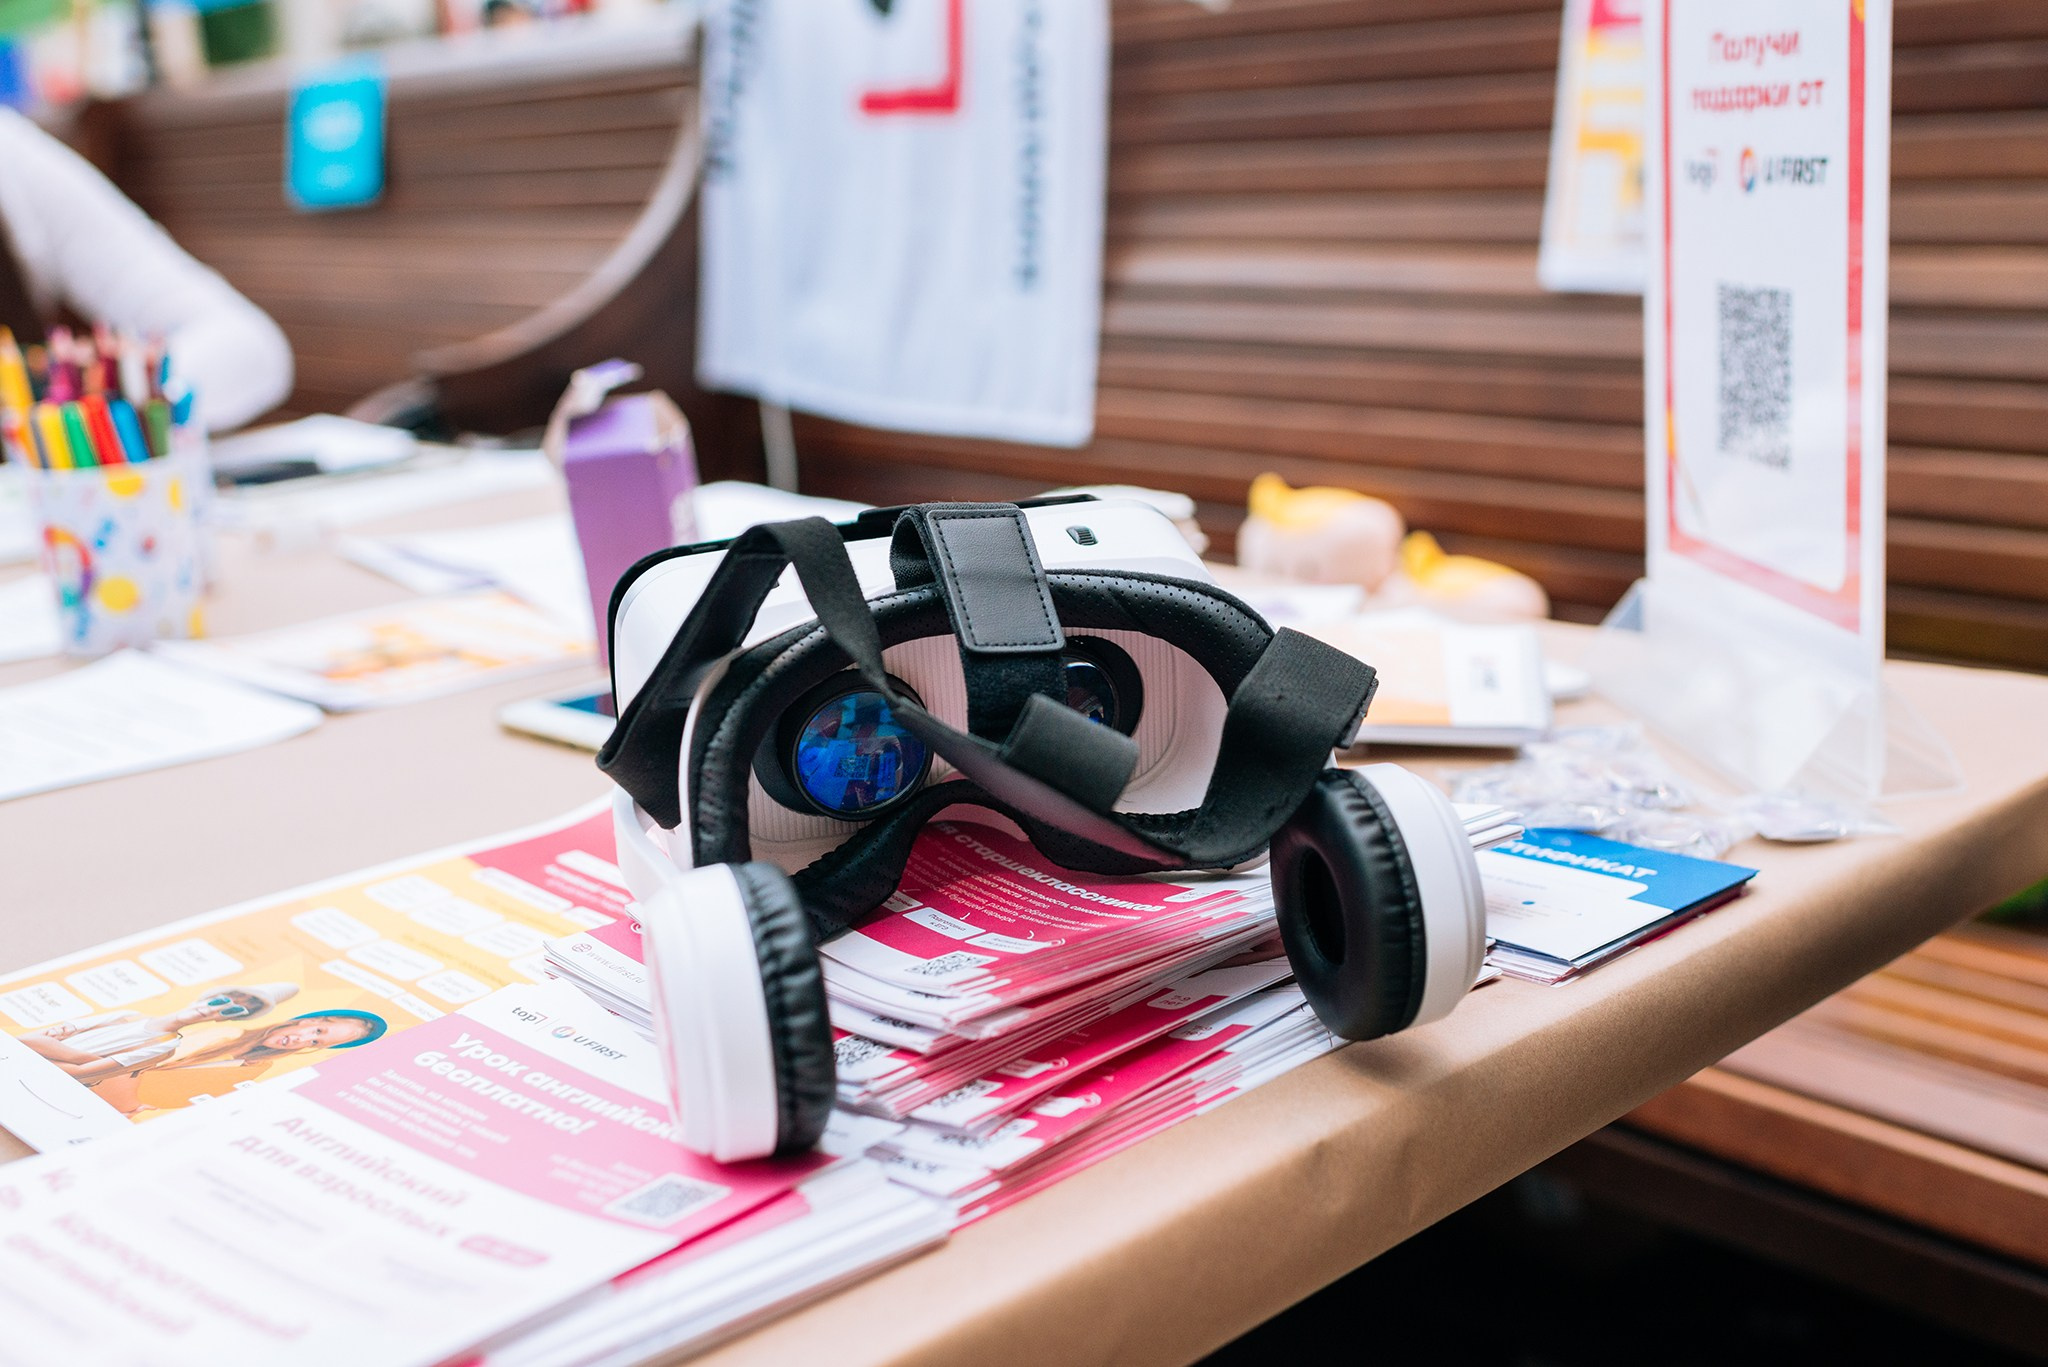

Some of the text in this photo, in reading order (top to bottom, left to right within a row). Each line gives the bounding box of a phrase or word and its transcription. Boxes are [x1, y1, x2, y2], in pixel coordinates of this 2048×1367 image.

[1711, 31, 1801, 66] Получи
[954, 834, 1167, 912] старшеклассников
[971, 874, 999, 890] своего
[999, 884, 1022, 900] места
[586, 951, 646, 984] www.ufirst.ru
[511, 1006, 538, 1023] top
[449, 1032, 530, 1078] Урок
[413, 1050, 598, 1136] бесплатно!
[227, 1134, 300, 1169] для
[271, 1115, 472, 1207] Английский
